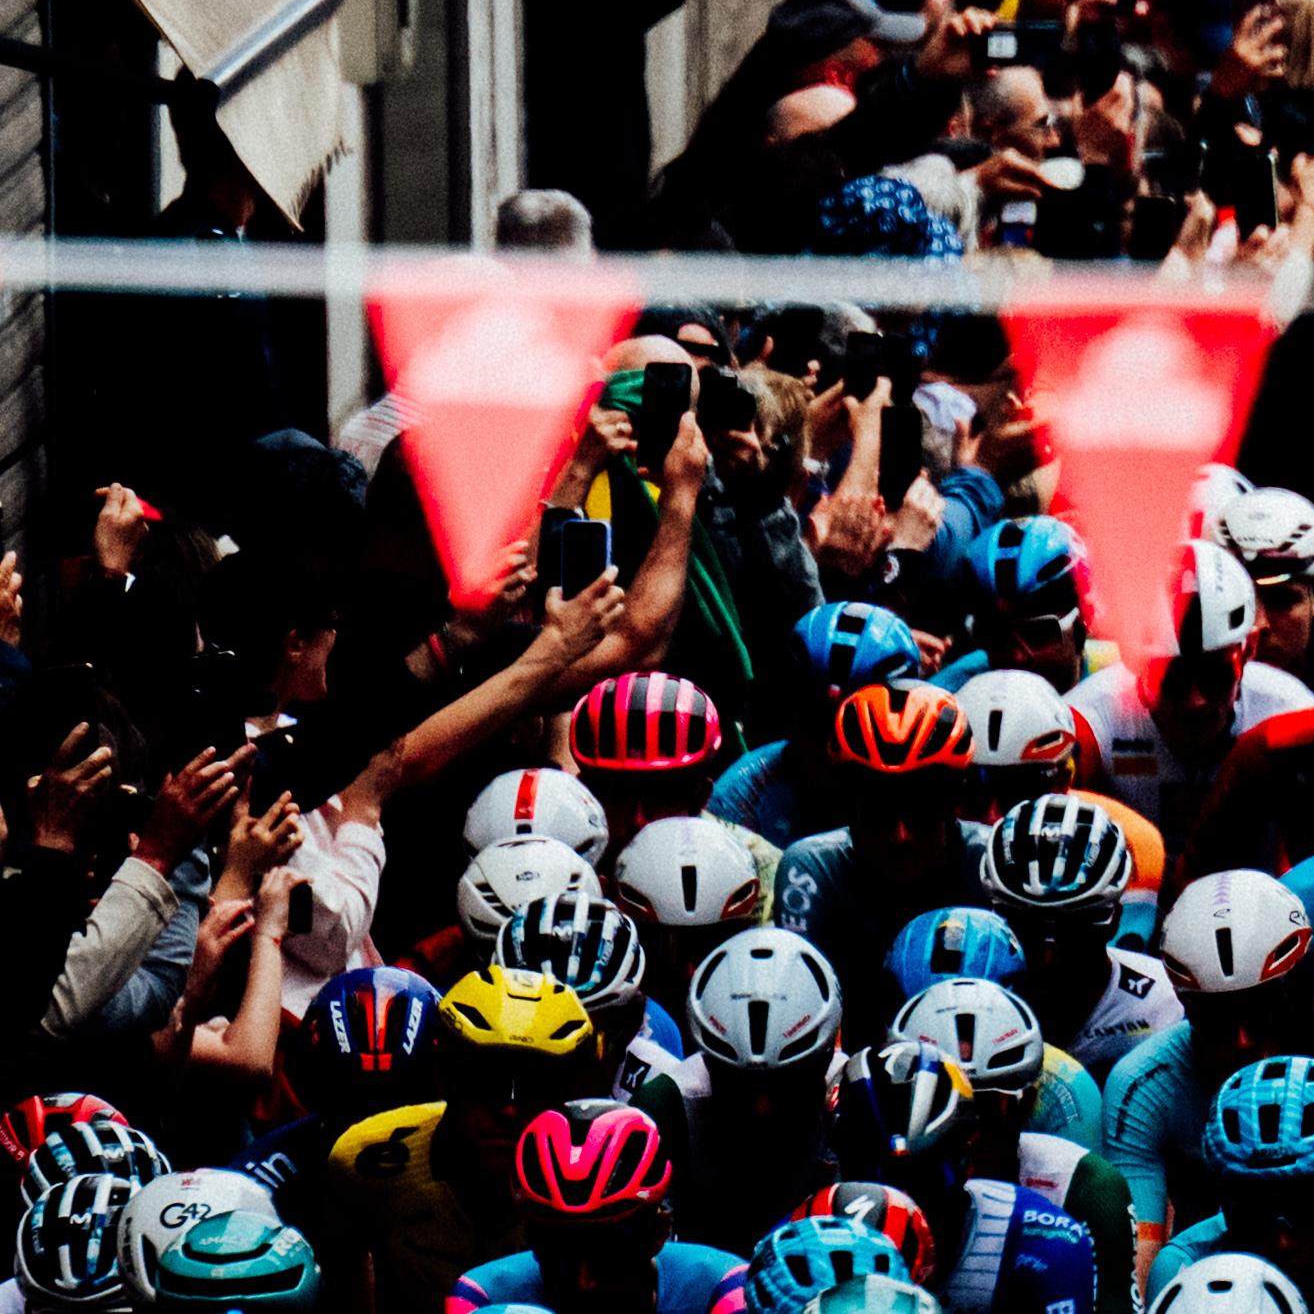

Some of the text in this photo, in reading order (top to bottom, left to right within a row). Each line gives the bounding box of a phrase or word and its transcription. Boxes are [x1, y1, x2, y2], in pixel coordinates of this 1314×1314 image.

[783, 866, 818, 933] EOS
[329, 1001, 351, 1054] LAZER
[402, 997, 424, 1055] LAZER
[1023, 1208, 1083, 1231] BORA
